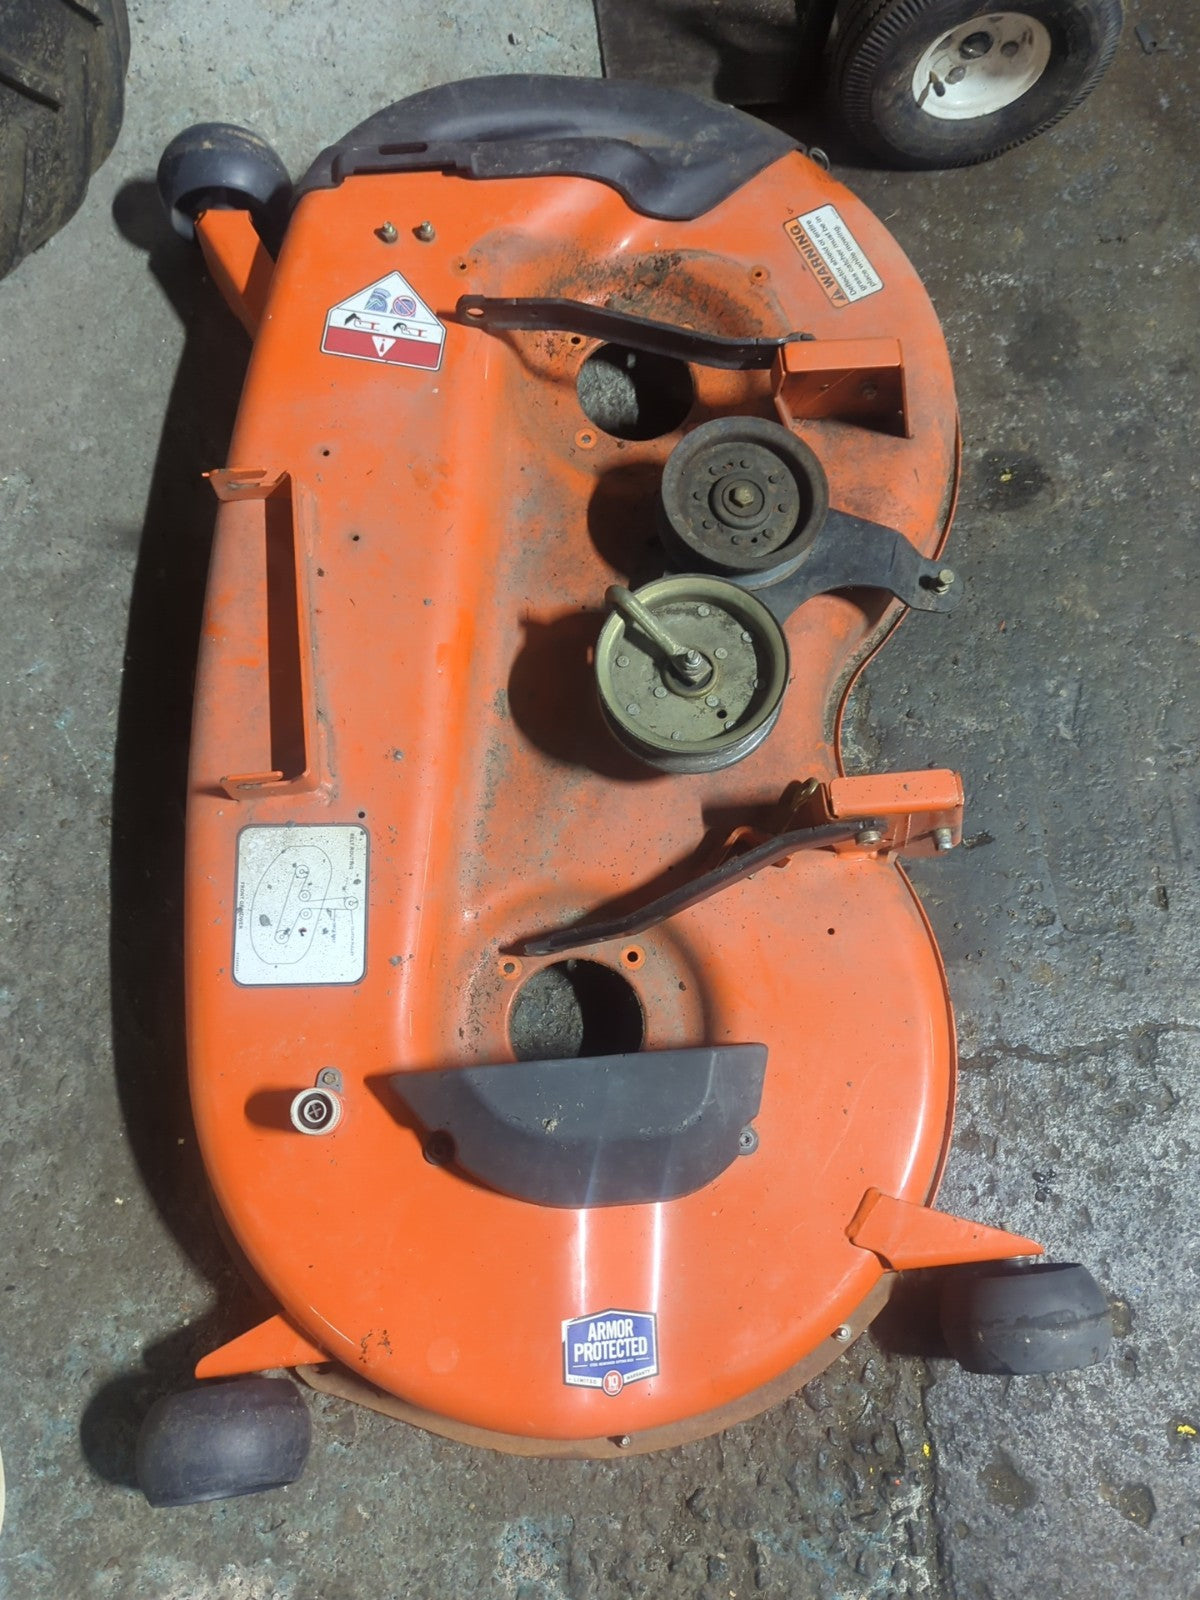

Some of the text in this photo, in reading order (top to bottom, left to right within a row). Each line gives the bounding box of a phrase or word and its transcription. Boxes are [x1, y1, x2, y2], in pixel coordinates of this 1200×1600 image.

[815, 215, 822, 223] in
[819, 223, 828, 232] be
[824, 232, 838, 249] must
[790, 225, 835, 289] WARNING
[806, 219, 857, 296] Deflector shield or entire
[836, 249, 854, 273] catcher
[850, 251, 864, 270] while
[852, 272, 868, 292] grass
[861, 269, 876, 288] place
[587, 1318, 634, 1342] ARMOR
[574, 1336, 648, 1363] PROTECTED
[573, 1377, 597, 1385] LIMITED
[626, 1369, 651, 1380] WARRANTY
